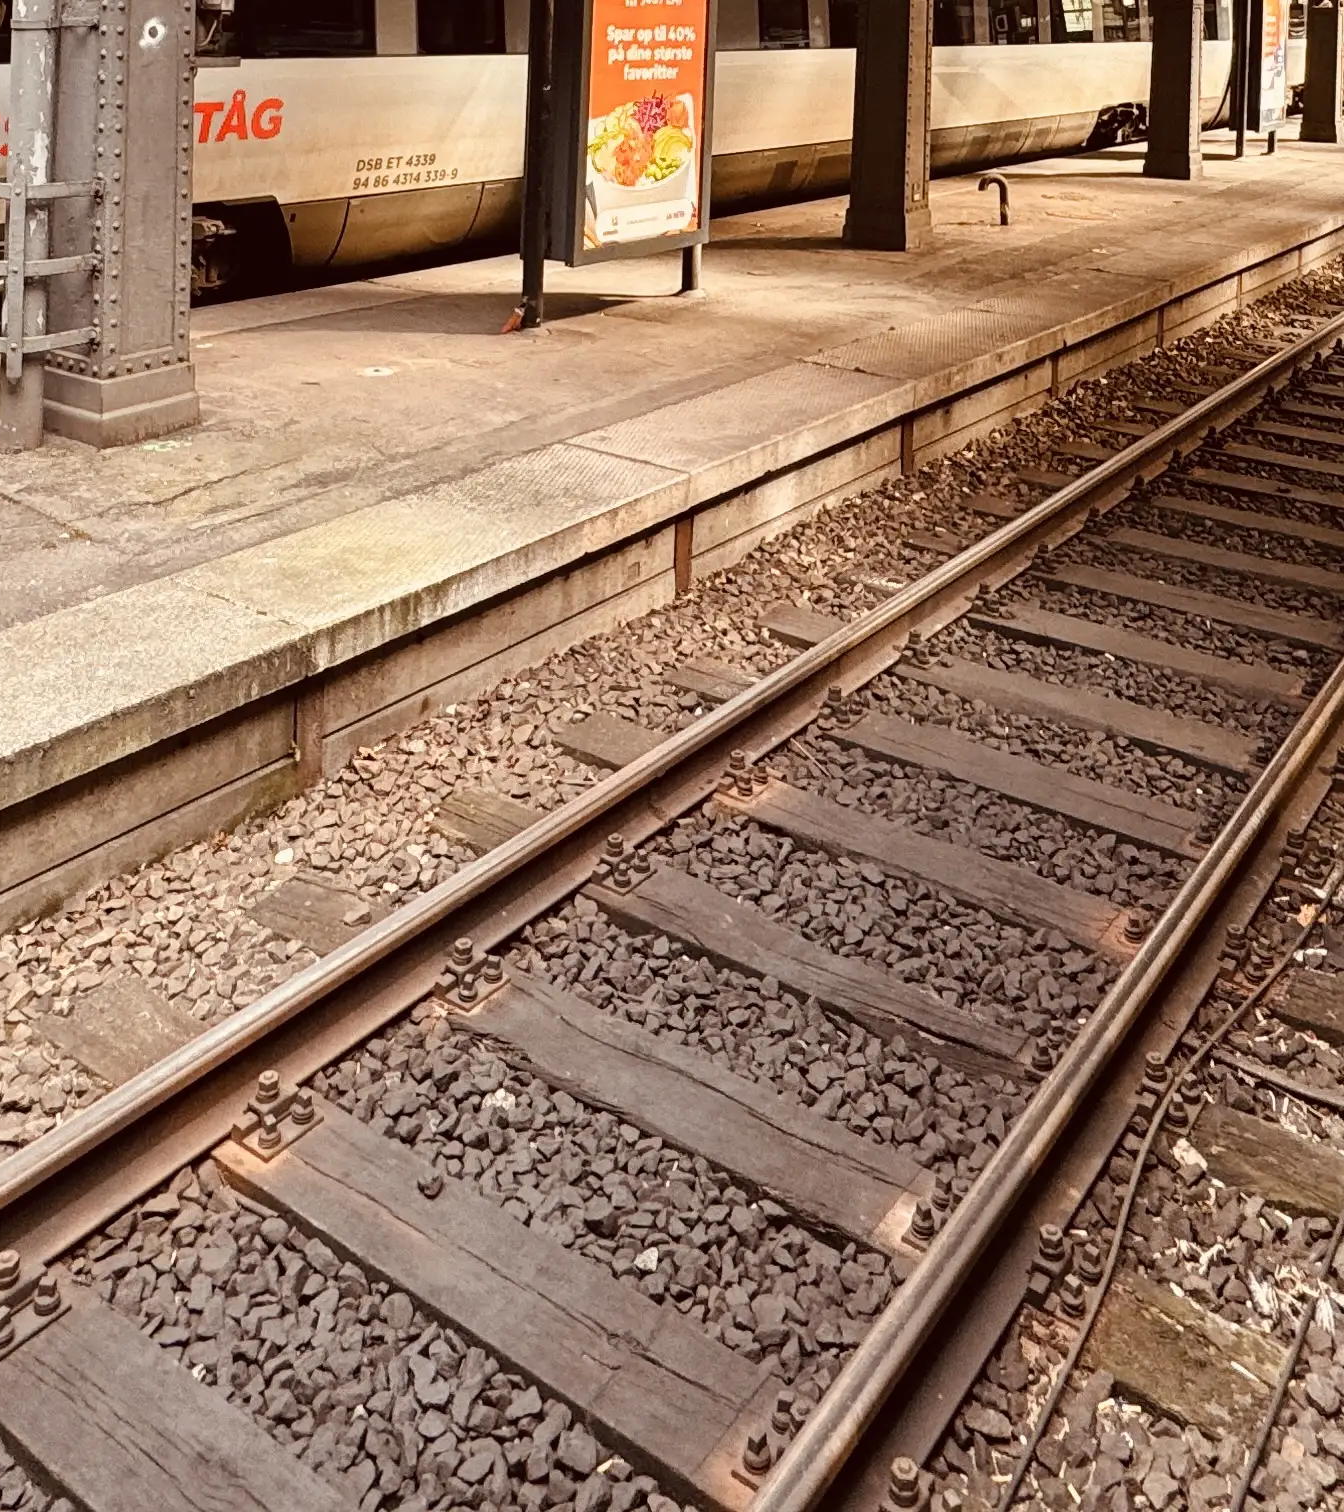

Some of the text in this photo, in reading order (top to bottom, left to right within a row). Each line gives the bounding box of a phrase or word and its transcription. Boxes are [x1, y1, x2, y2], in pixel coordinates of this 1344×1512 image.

[606, 24, 696, 45] Spar op til 40%
[608, 43, 693, 64] på dine største
[623, 63, 679, 81] favoritter
[356, 153, 437, 172] DSB ET 4339
[353, 176, 370, 190] 94
[373, 174, 389, 187] 86
[392, 172, 421, 186] 4314
